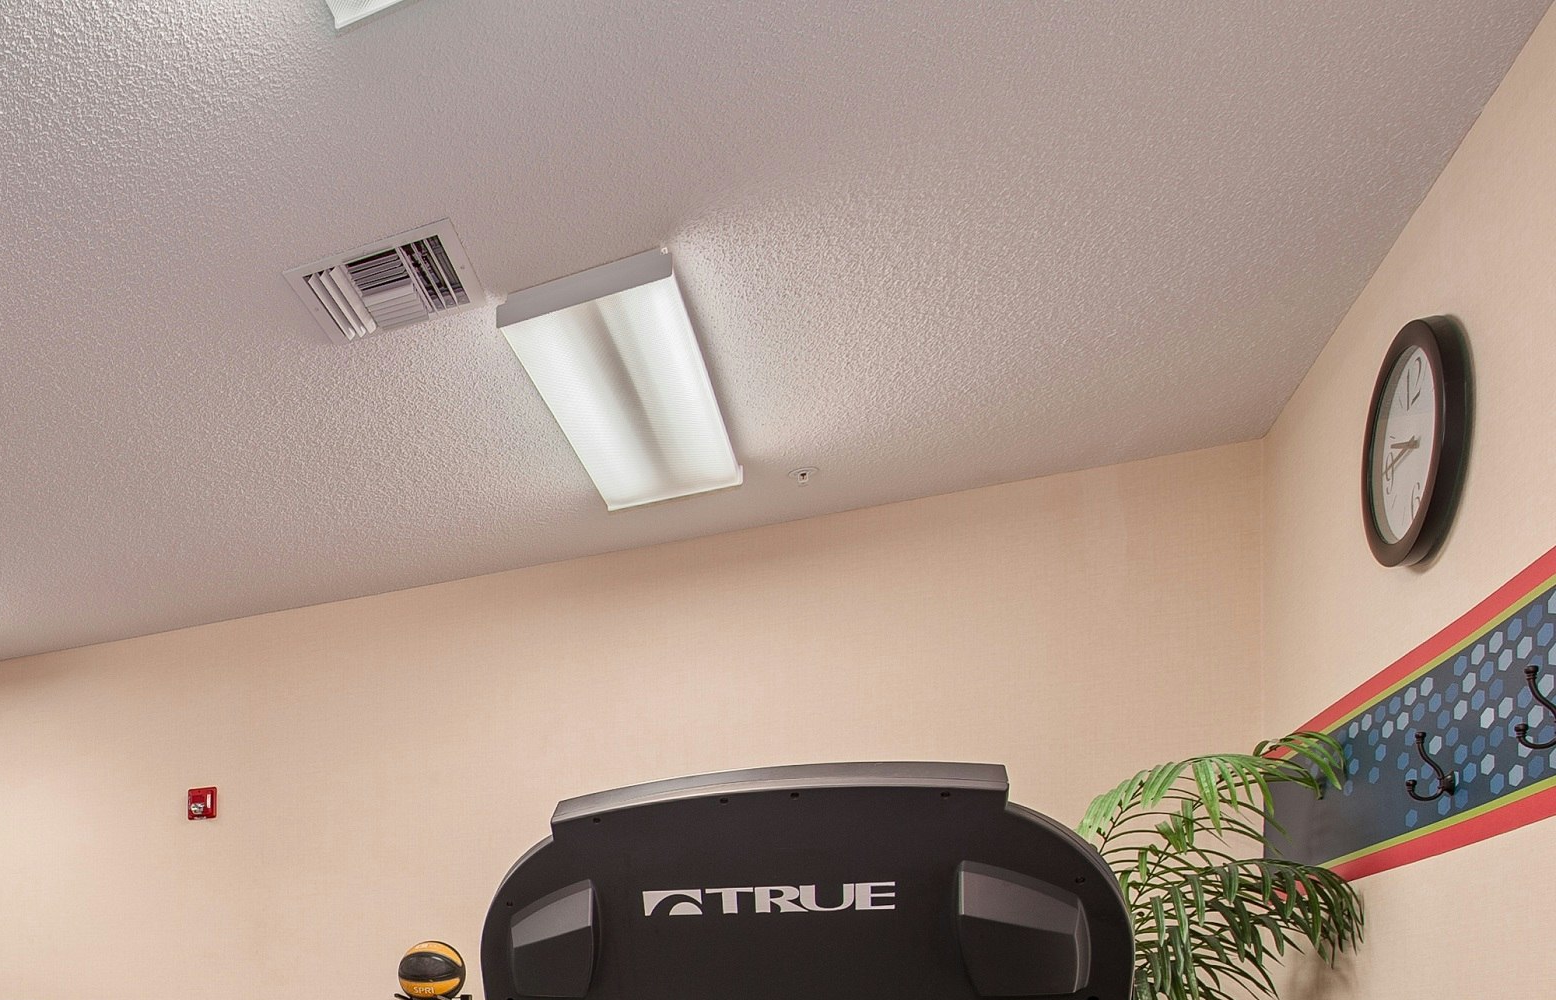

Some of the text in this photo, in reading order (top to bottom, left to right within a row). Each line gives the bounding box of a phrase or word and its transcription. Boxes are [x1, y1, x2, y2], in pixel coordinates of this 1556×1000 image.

[1406, 356, 1423, 412] 12
[1385, 451, 1395, 496] 9
[705, 881, 895, 914] TRUE
[413, 986, 435, 994] SPRI
